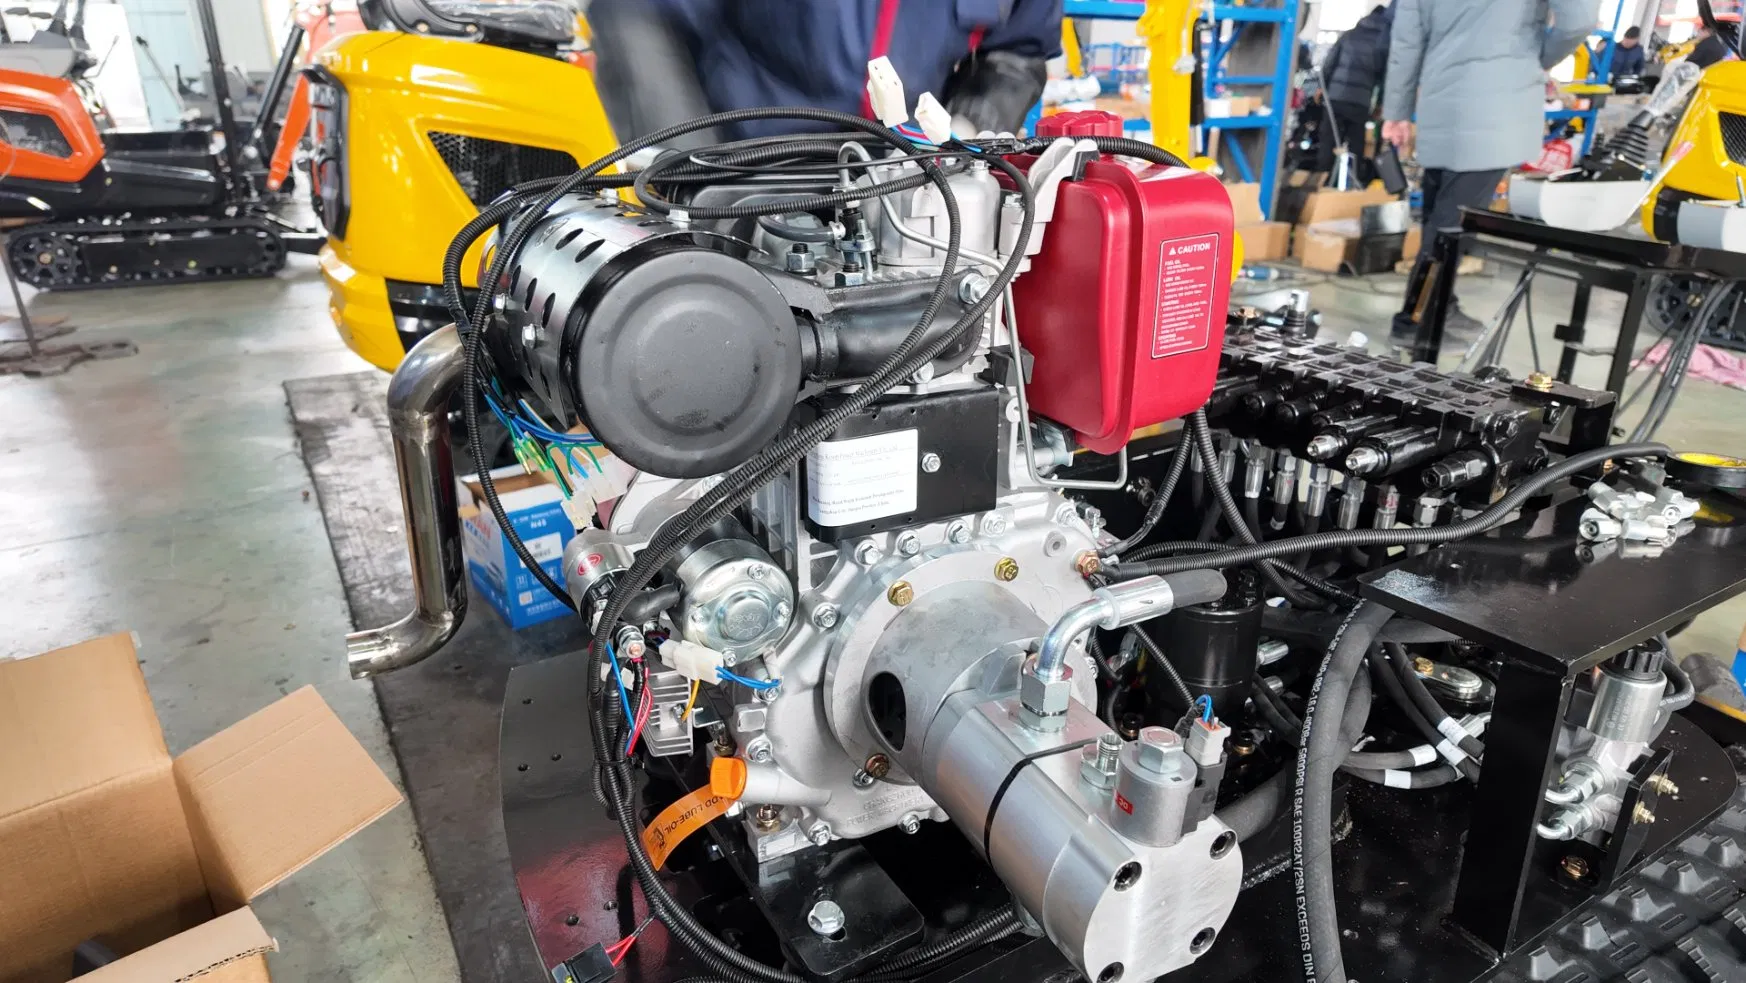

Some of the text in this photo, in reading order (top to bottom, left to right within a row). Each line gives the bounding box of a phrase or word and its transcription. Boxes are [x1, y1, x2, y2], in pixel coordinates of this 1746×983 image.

[1177, 242, 1211, 255] CAUTION
[1295, 748, 1307, 787] 5800PSI
[663, 803, 704, 835] LUBE-OIL
[1293, 798, 1303, 817] SAE
[1293, 819, 1305, 895] 100R2AT/2SN
[1296, 896, 1311, 951] EXCEEDS
[1302, 953, 1315, 976] DIN
